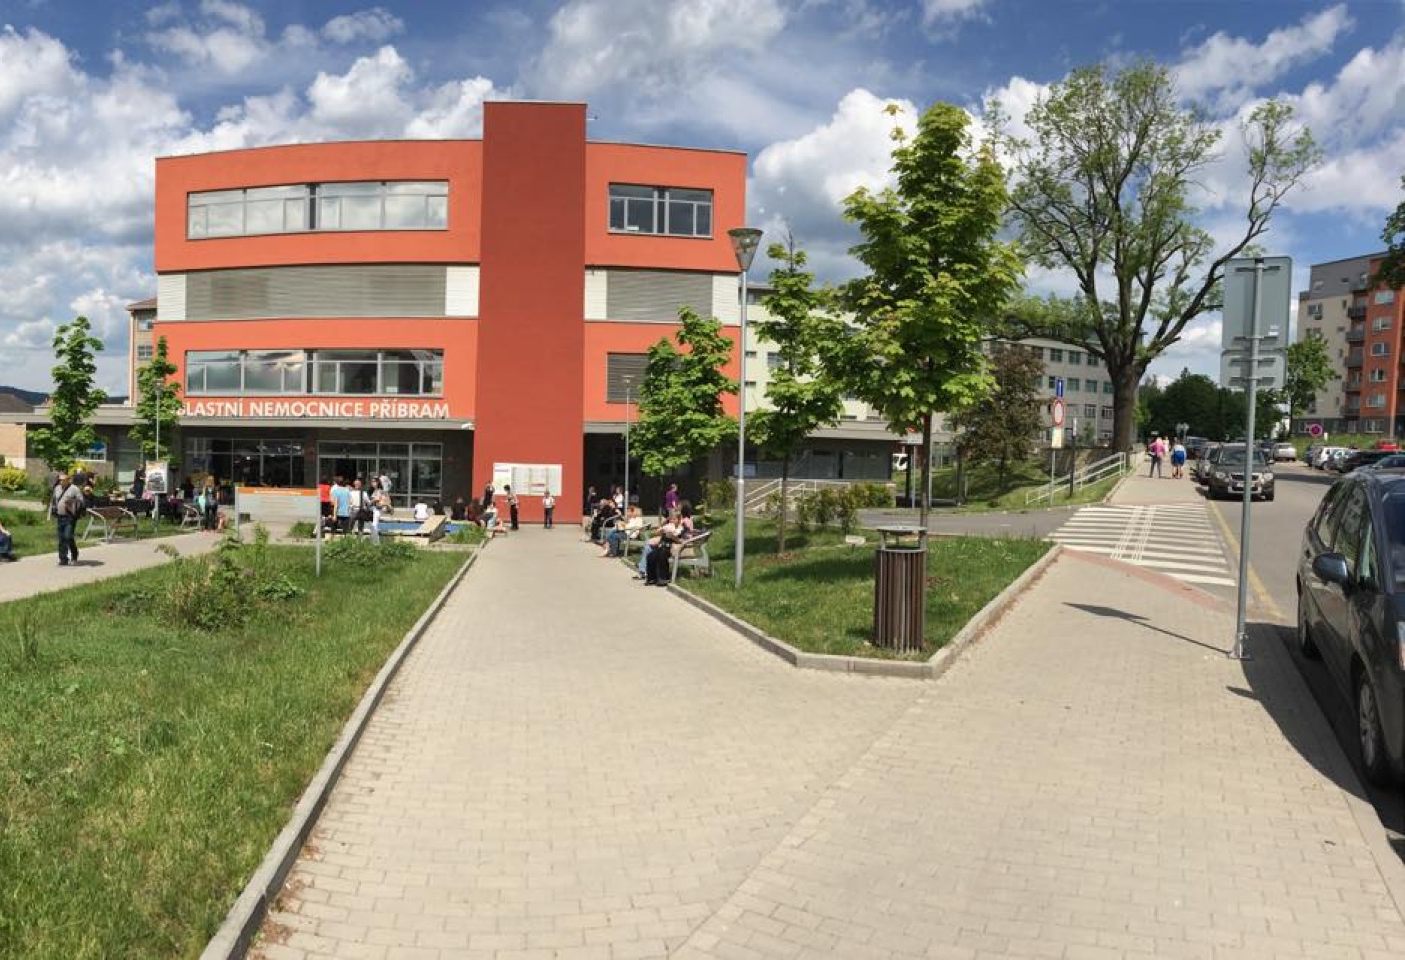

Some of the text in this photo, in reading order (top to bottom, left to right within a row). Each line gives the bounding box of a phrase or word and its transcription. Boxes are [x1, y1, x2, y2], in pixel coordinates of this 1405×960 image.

[177, 397, 449, 418] BLASTNÍ NEMOCNICE PŘÍBRAM
